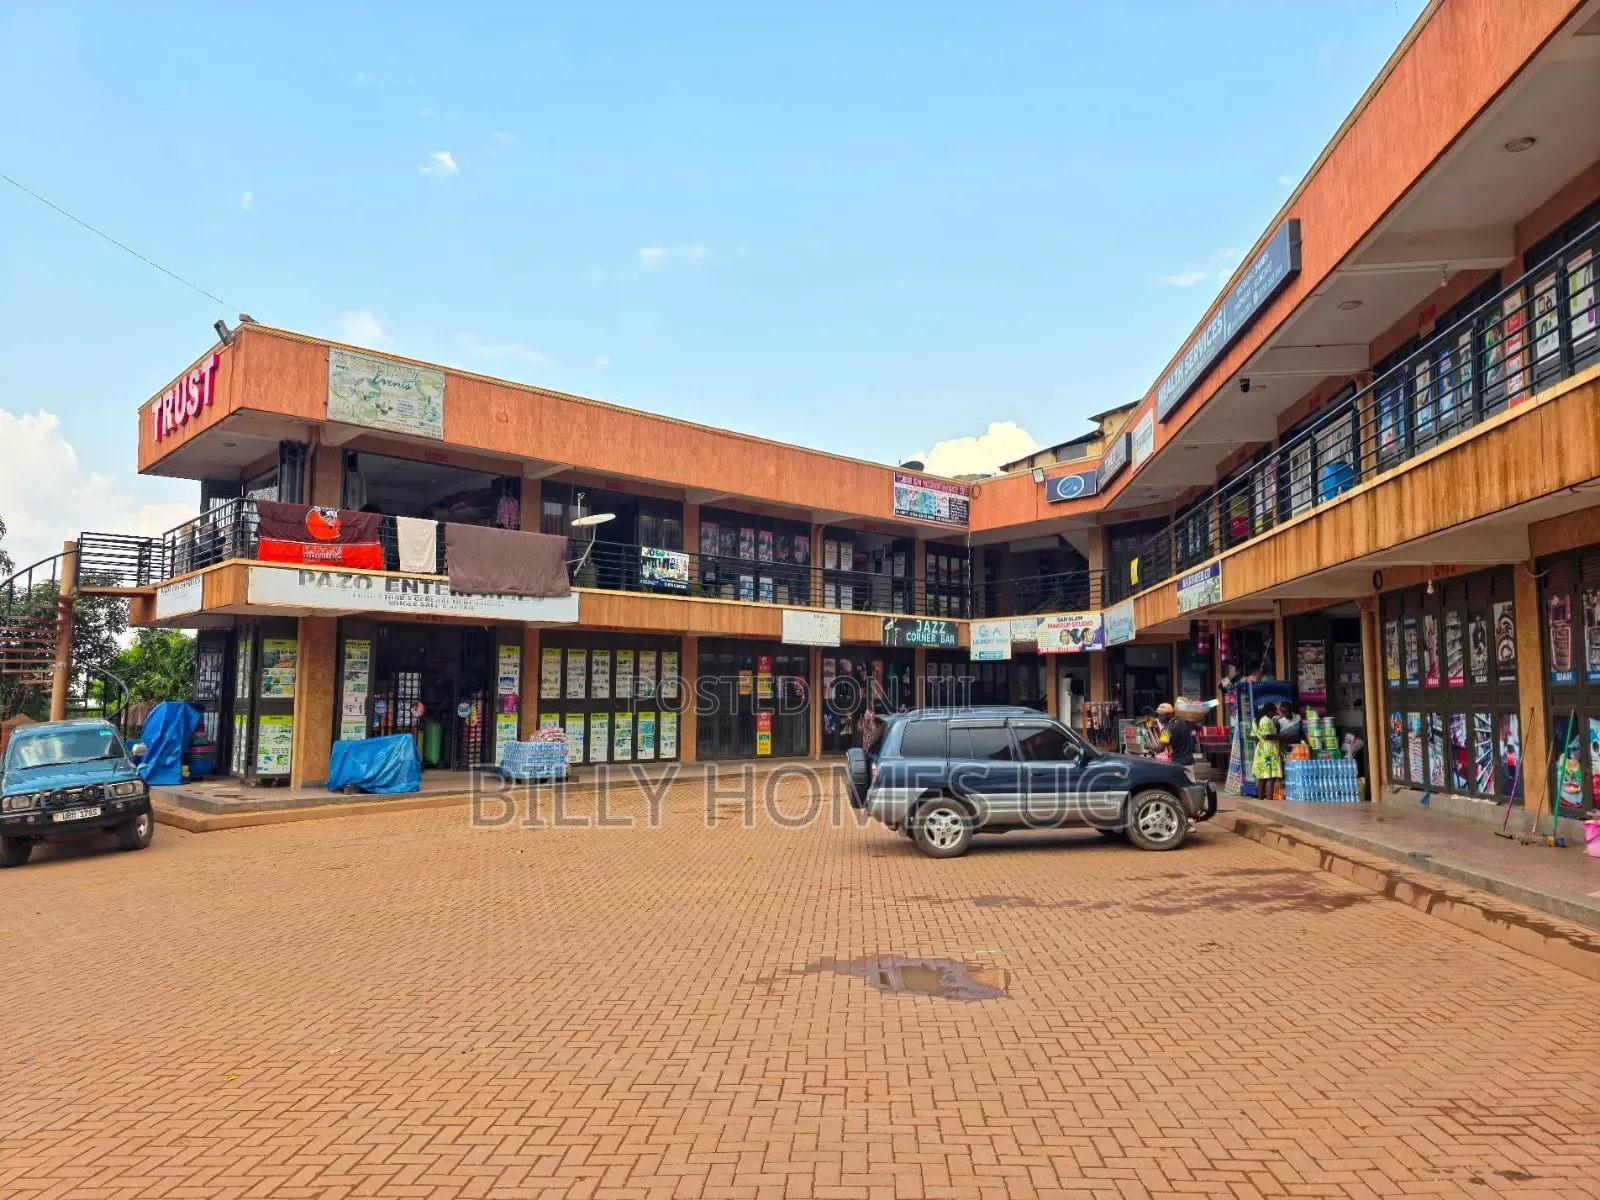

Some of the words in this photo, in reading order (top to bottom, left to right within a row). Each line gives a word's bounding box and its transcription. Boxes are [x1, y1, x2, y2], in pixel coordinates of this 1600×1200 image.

[1184, 309, 1223, 376] SERVICES
[152, 352, 219, 443] TRUST
[298, 569, 374, 590] PAZO
[916, 620, 947, 634] JAZZ
[906, 632, 936, 643] CORNER
[940, 634, 955, 644] BAR
